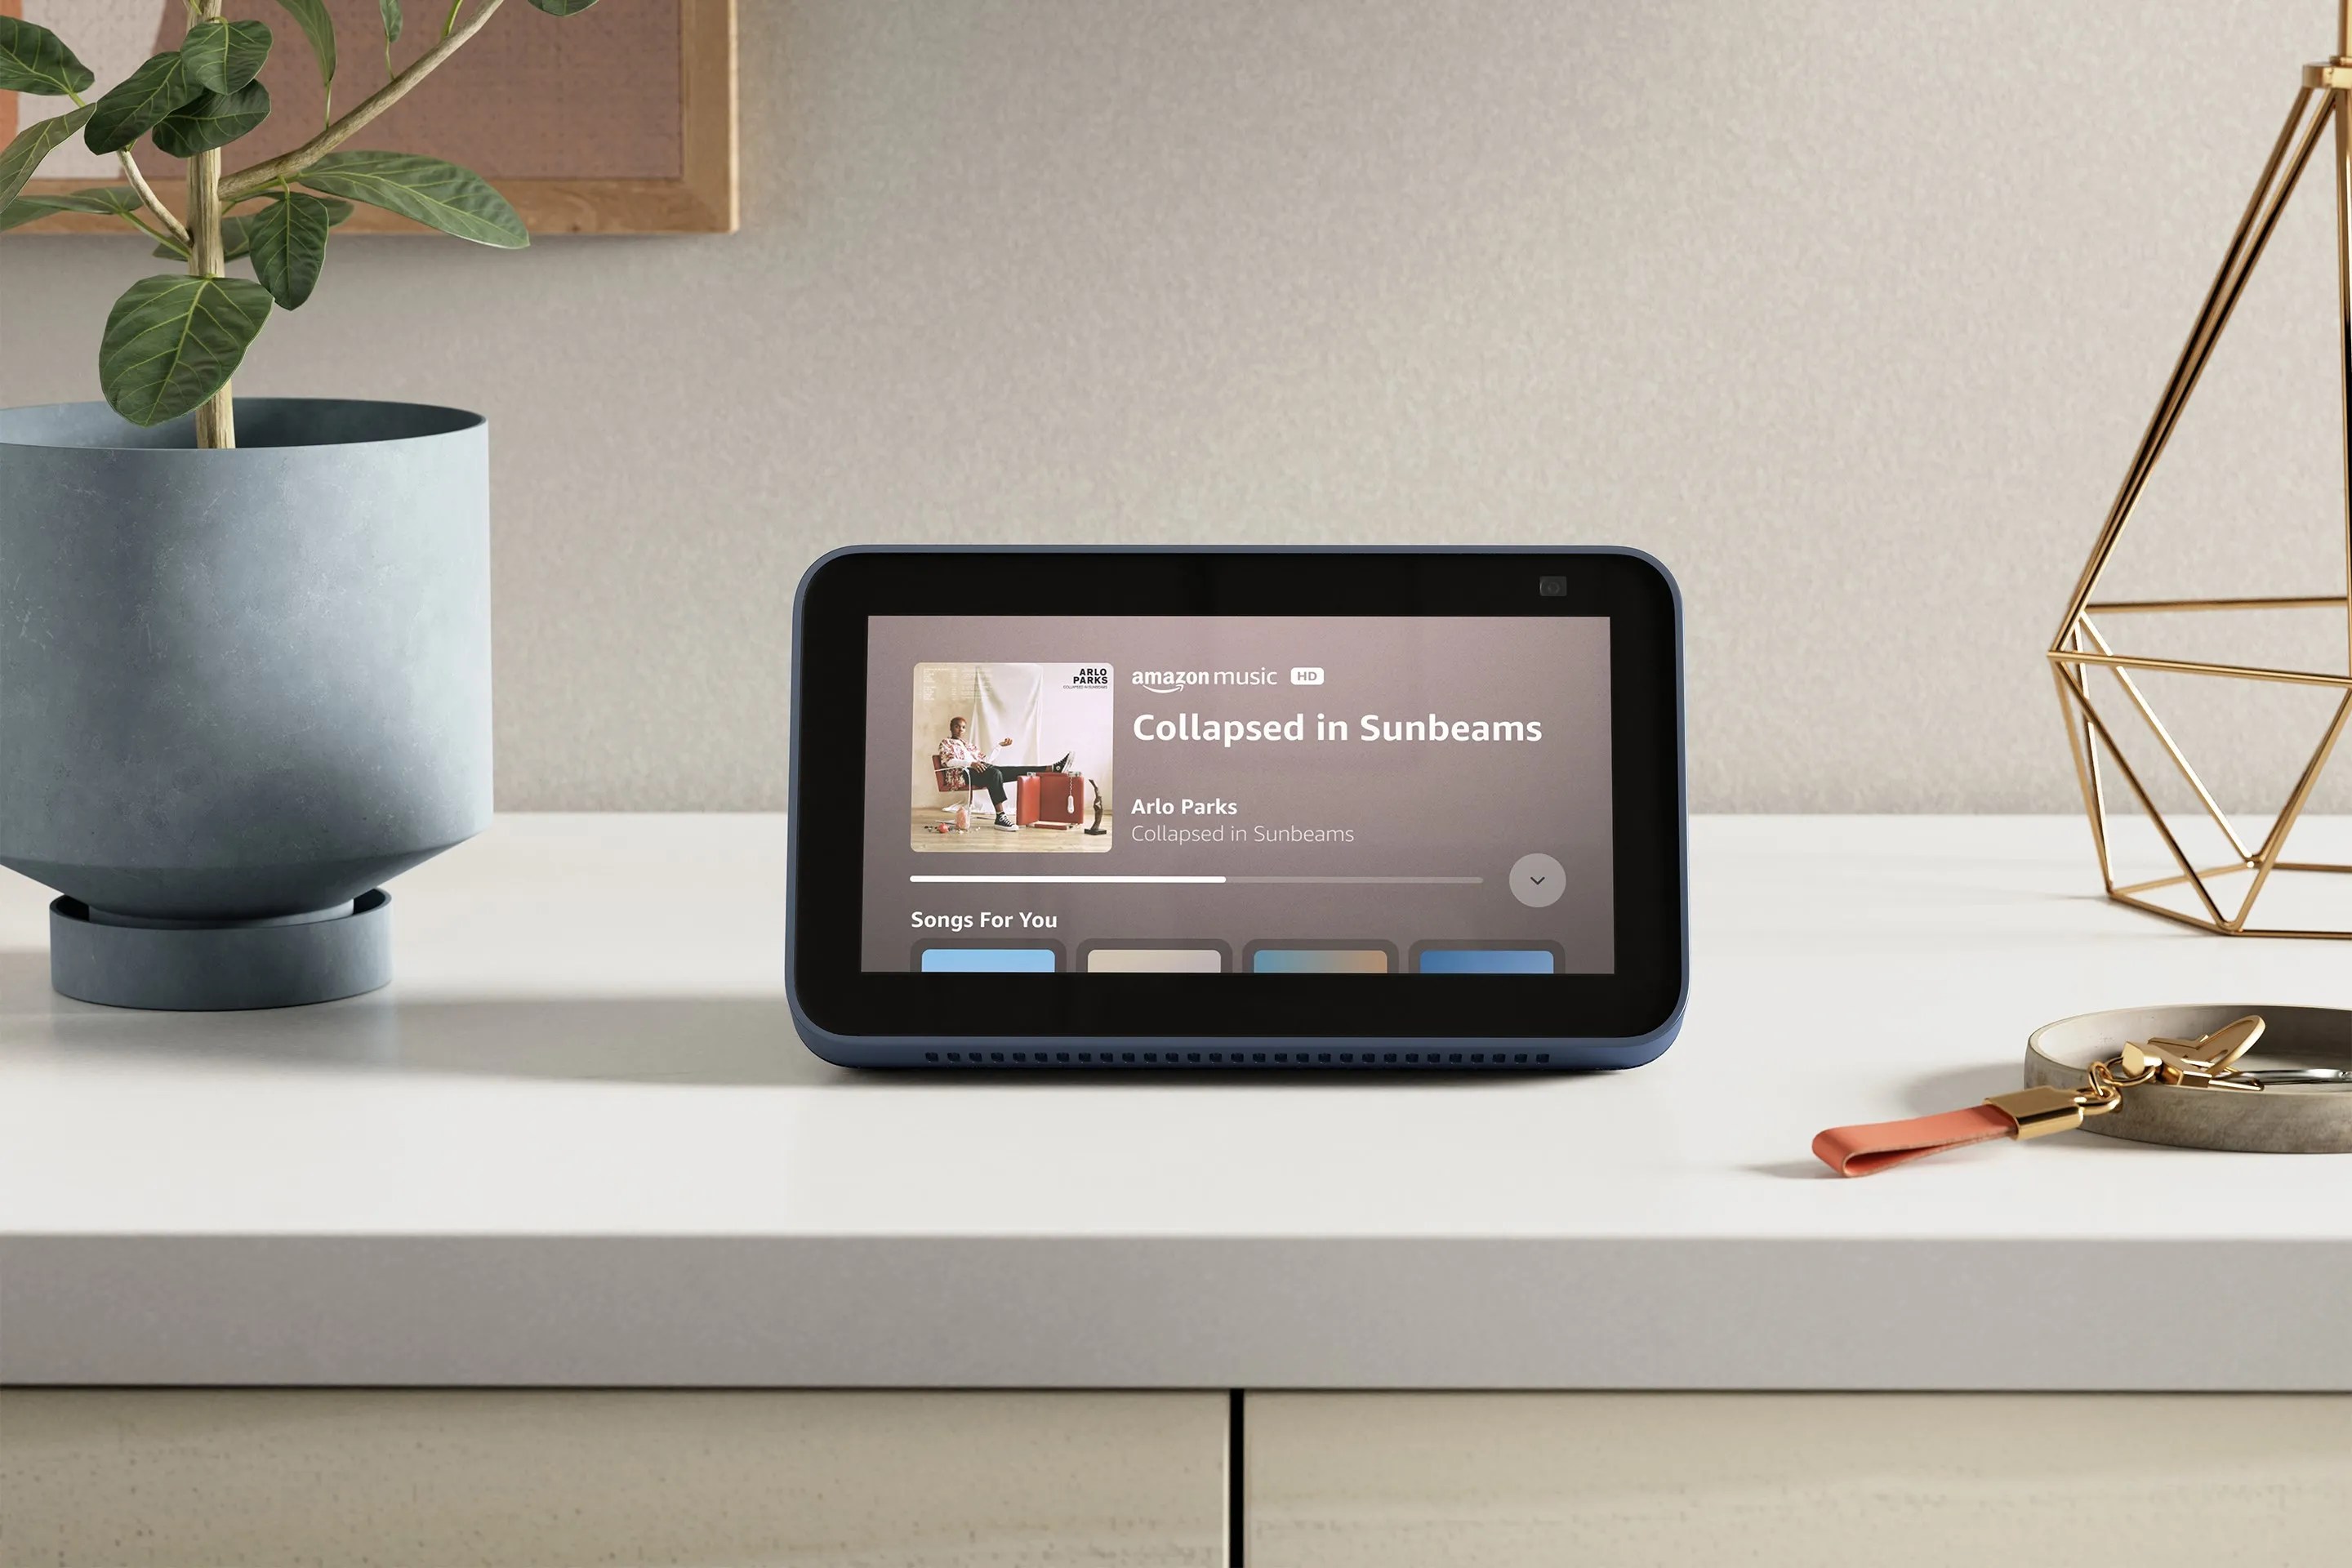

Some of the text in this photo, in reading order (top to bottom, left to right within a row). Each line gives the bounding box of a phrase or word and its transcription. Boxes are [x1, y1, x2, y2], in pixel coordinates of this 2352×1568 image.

[1073, 676, 1108, 684] PARKS
[1079, 668, 1107, 676] ARLO
[1131, 666, 1317, 687] amazon music HD
[1133, 712, 1543, 748] Collapsed in Sunbeams
[1130, 797, 1238, 816] Arlo Parks
[1131, 824, 1355, 846] Collapsed in Sunbeams
[911, 911, 1058, 933] Songs For You
